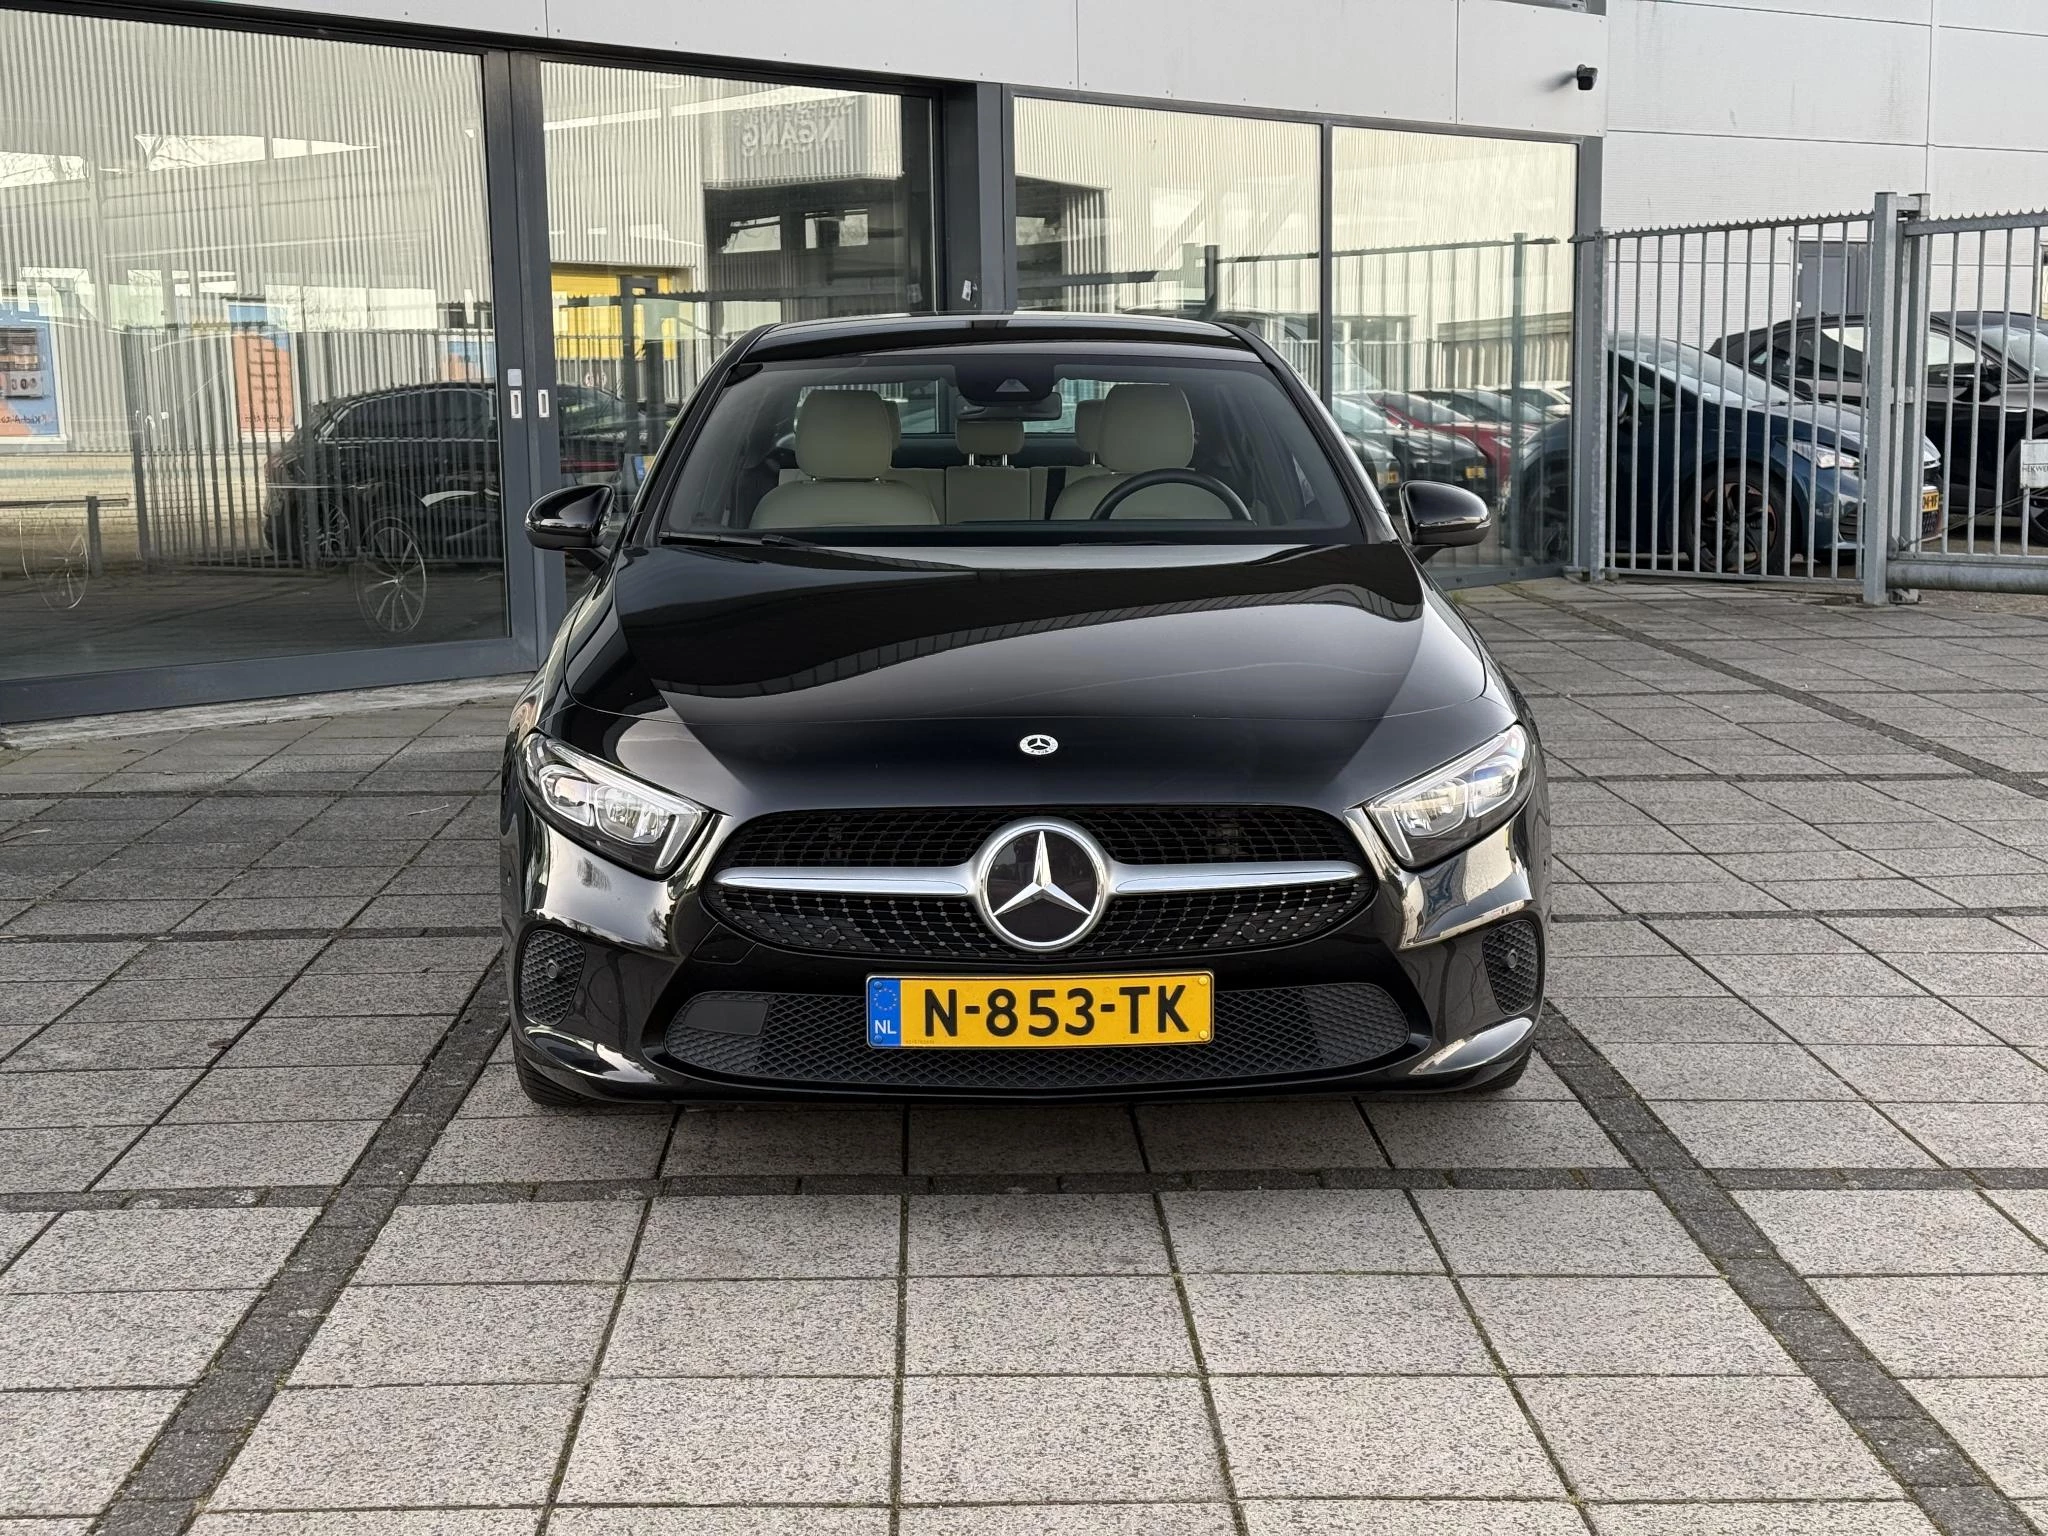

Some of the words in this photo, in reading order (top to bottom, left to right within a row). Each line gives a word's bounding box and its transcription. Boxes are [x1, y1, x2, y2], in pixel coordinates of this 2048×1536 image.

[2021, 464, 2048, 472] HEKWE
[924, 984, 1190, 1038] N-853-TK
[874, 1019, 897, 1034] NL
